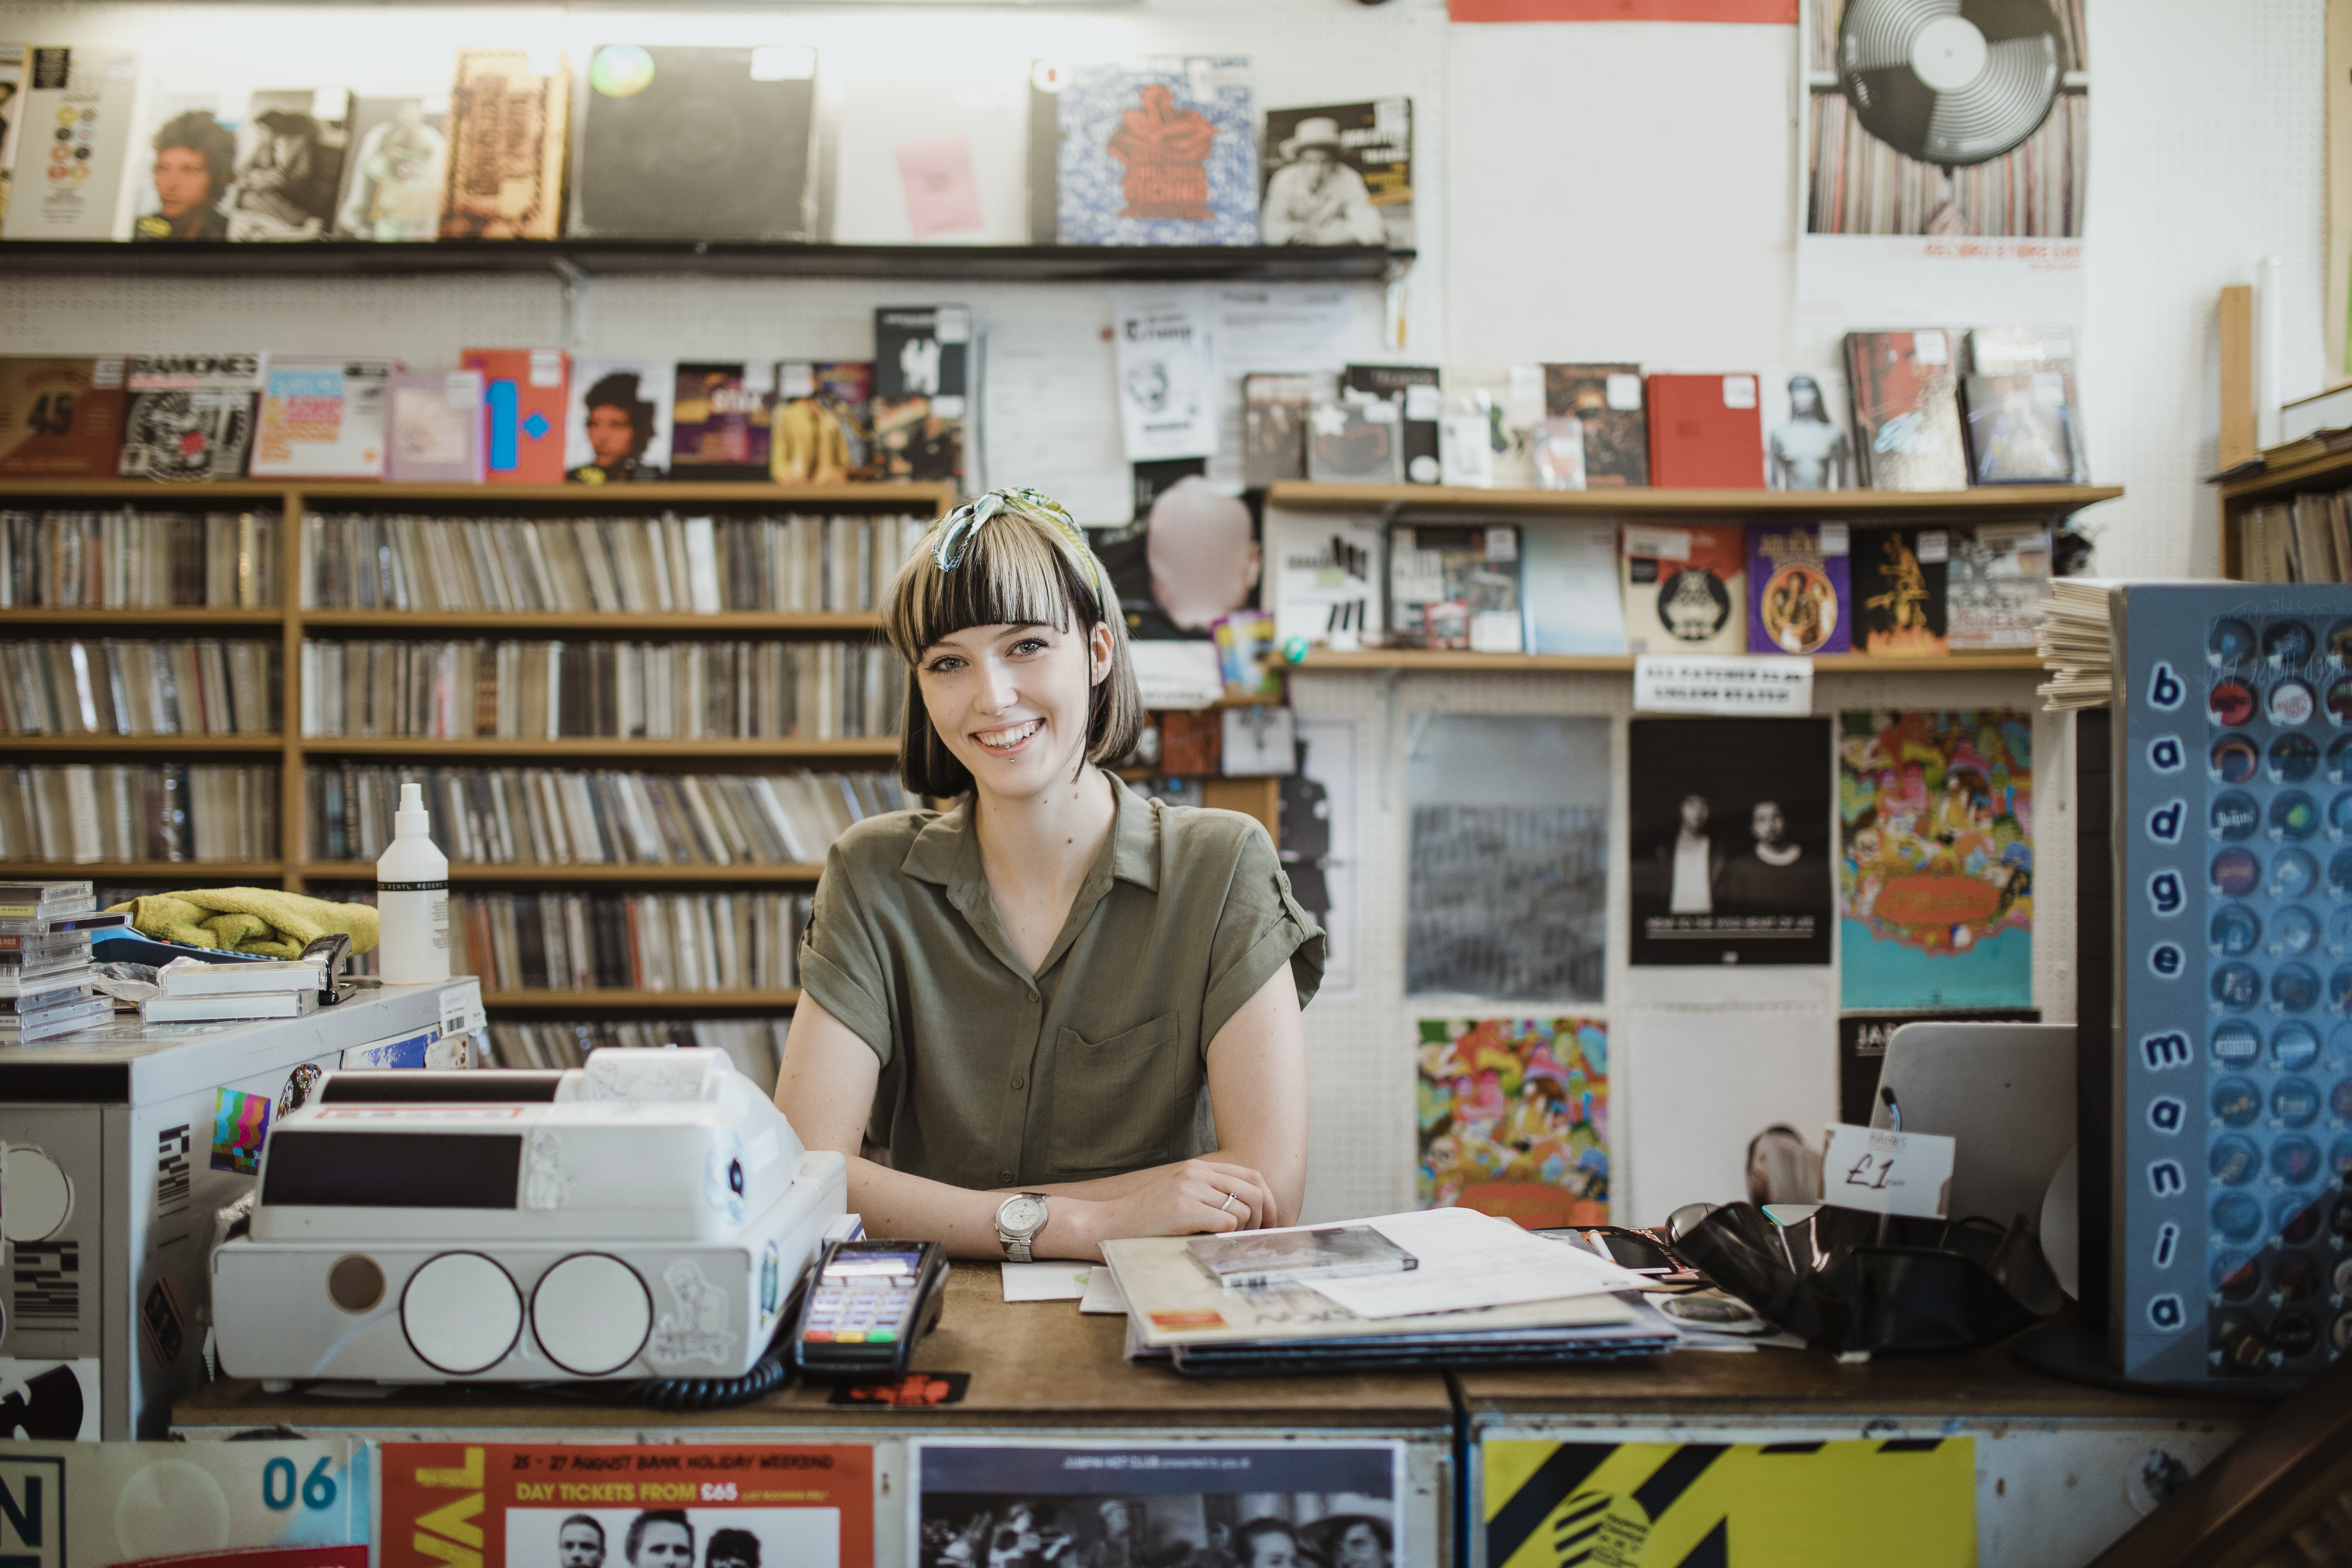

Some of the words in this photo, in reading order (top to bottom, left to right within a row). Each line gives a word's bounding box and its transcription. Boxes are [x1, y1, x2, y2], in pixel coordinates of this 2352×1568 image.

[133, 355, 258, 377] RAMONES
[28, 393, 73, 435] 45
[1846, 1153, 1895, 1189] £1
[549, 1455, 568, 1470] 27
[572, 1455, 632, 1471] AUGUST
[637, 1455, 682, 1470] BANK
[687, 1456, 755, 1470] HOLIDAY
[759, 1455, 834, 1470] WEEKEND
[262, 1456, 338, 1511] 06
[516, 1482, 555, 1501] DAY
[559, 1482, 636, 1502] TICKETS
[640, 1482, 697, 1501] FROM
[701, 1482, 738, 1501] £65
